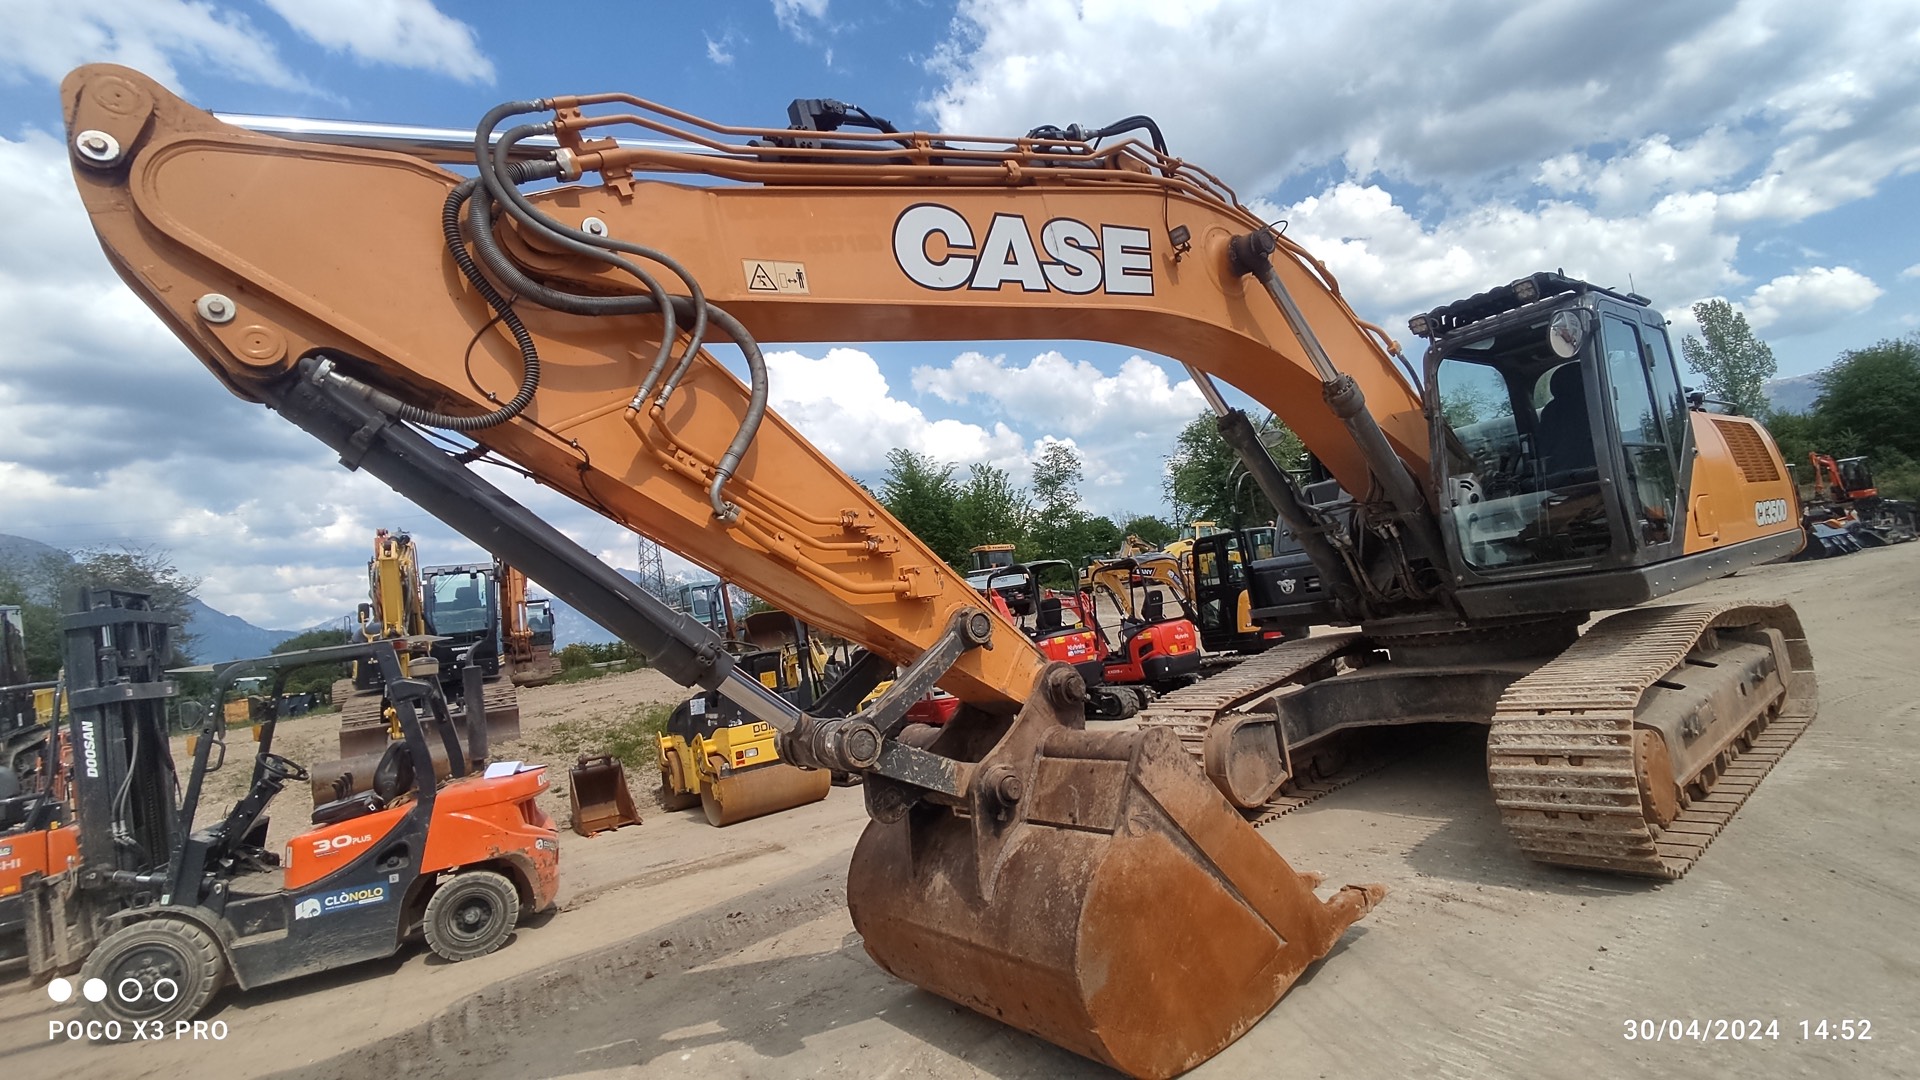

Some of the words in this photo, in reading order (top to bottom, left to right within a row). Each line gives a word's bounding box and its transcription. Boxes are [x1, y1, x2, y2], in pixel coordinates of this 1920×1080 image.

[892, 202, 1155, 296] CASE
[81, 720, 99, 778] DOOSAN
[313, 835, 353, 853] 30
[352, 834, 372, 844] PLUS
[324, 887, 384, 906] CLÒNOLO
